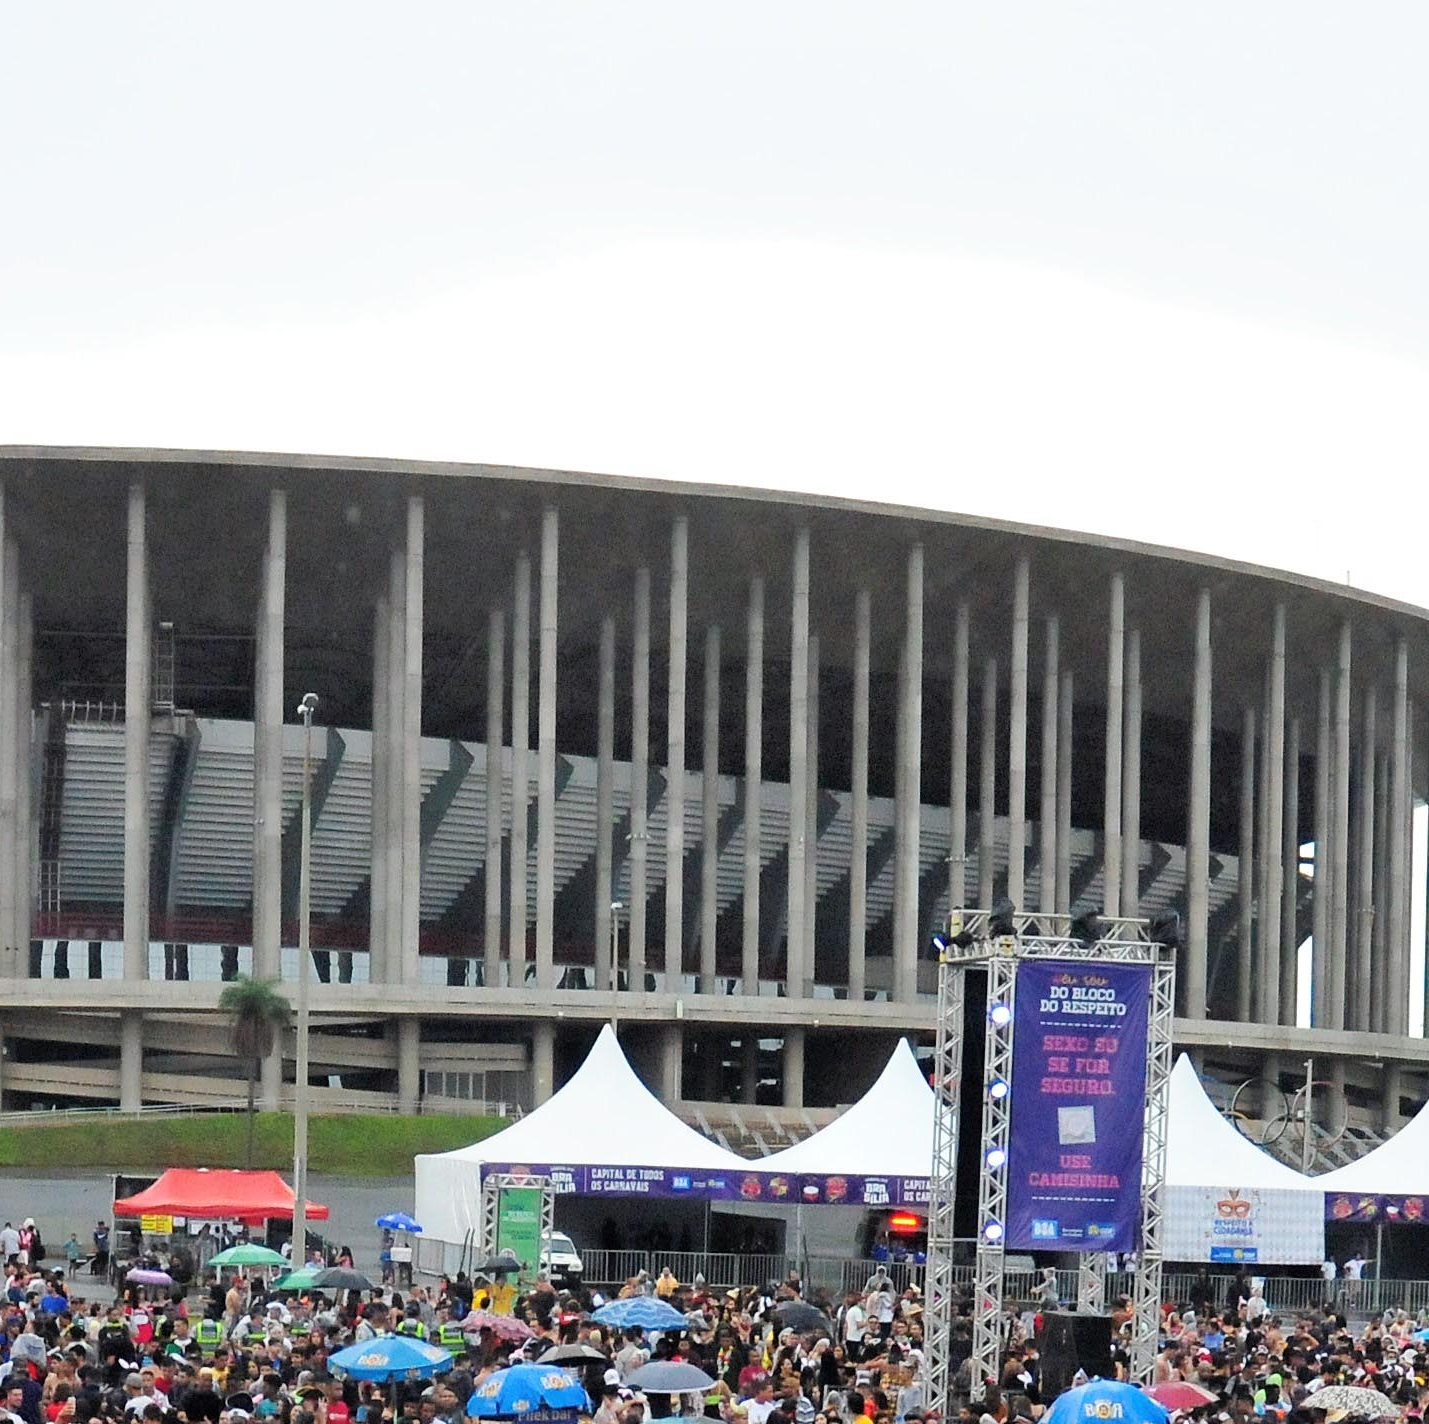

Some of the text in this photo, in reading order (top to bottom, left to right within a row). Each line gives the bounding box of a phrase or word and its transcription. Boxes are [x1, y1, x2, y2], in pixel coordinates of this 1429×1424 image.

[1050, 986, 1116, 1001] DO BLOCO
[1039, 1000, 1127, 1017] DO RESPEITO
[1048, 1056, 1110, 1074] SE FOR
[1041, 1077, 1116, 1095] SEGURO.
[1059, 1154, 1091, 1169] USE
[591, 1168, 623, 1180] CAPITAL
[626, 1169, 636, 1180] DE
[639, 1169, 664, 1181] TODOS
[1029, 1172, 1121, 1188] CAMISINHA
[591, 1180, 602, 1191] OS
[603, 1181, 649, 1192] CARNAVAIS
[904, 1192, 915, 1203] OS
